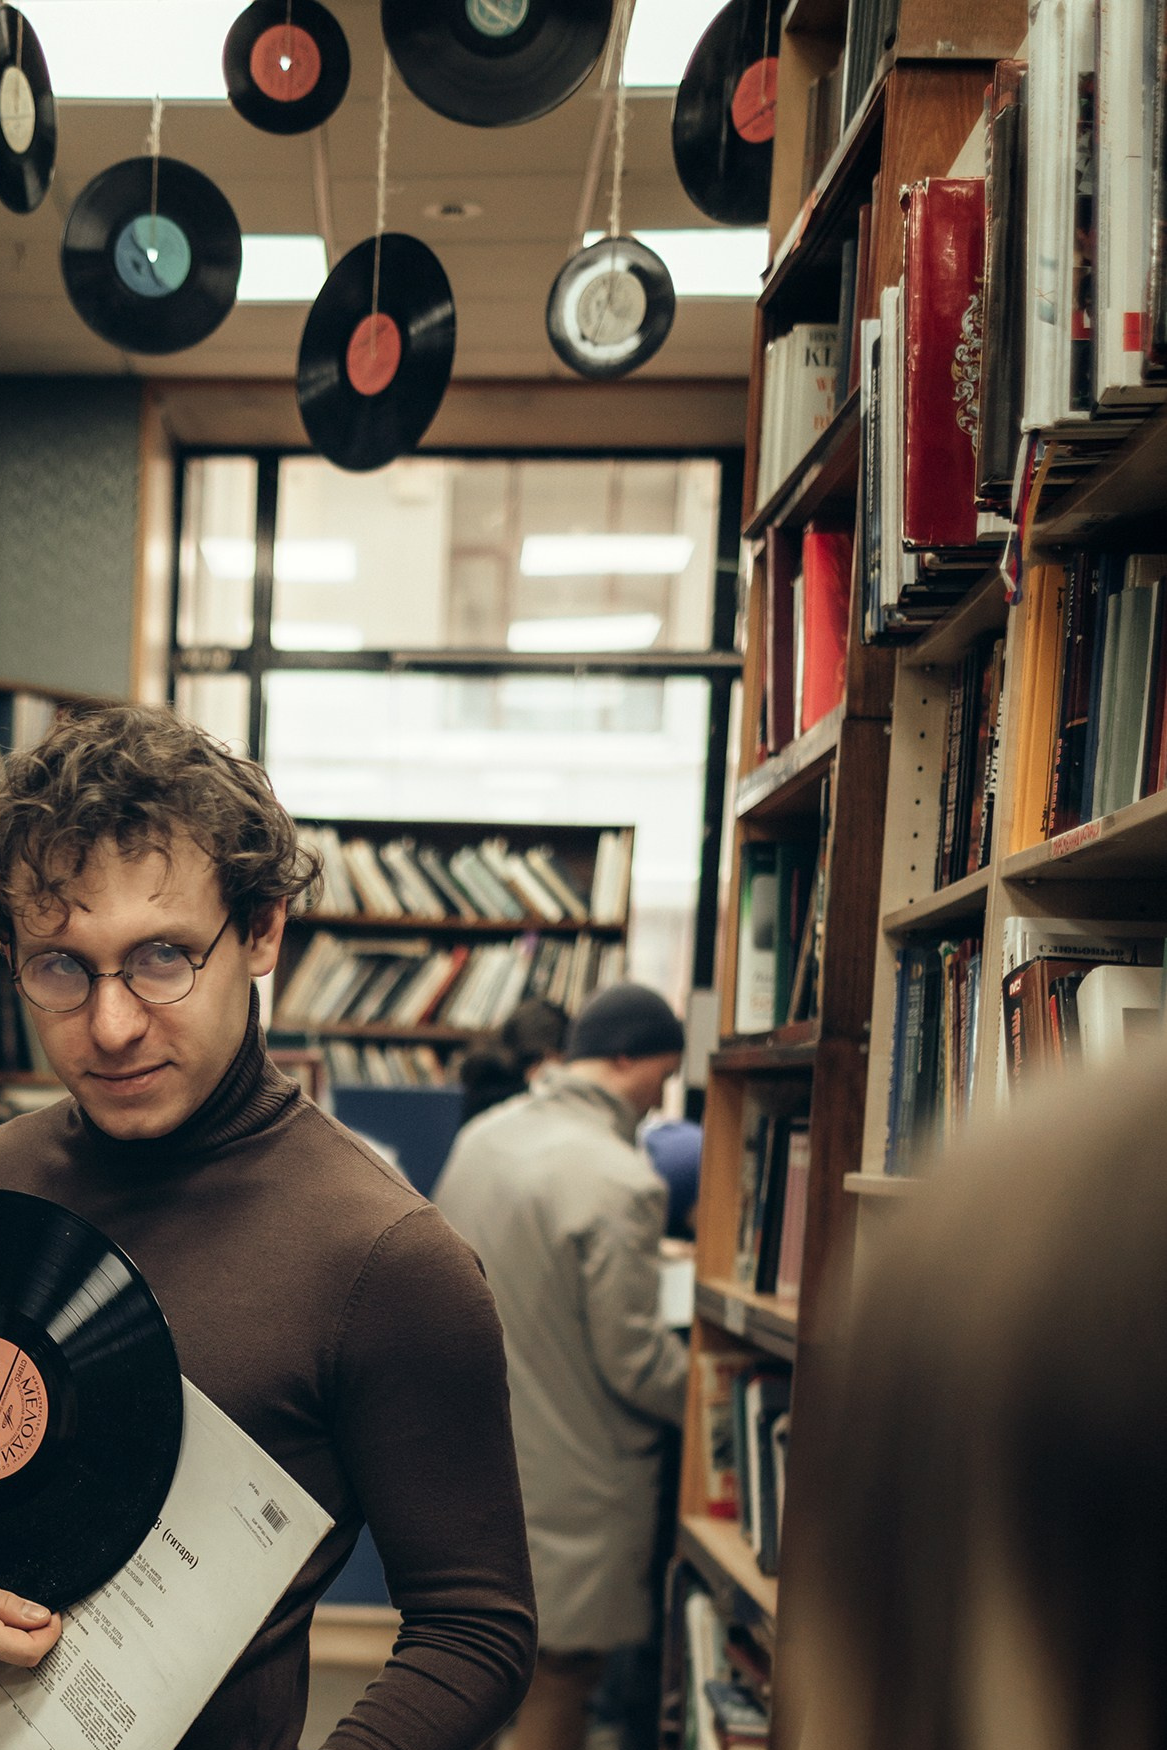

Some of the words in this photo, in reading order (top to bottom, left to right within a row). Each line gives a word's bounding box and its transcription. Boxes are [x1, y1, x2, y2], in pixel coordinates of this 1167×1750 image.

[1038, 944, 1047, 953] С
[1048, 944, 1124, 958] ЛЮБОВЬЮ
[13, 1358, 28, 1382] СТЕРЕО
[161, 1528, 200, 1569] (гитара)
[143, 1570, 160, 1587] ТАНЕЦ
[119, 1590, 136, 1607] ПЕСНИ
[92, 1616, 100, 1624] ОБ
[98, 1623, 124, 1649] АЛЬГАМБРЕ
[93, 1608, 102, 1616] НА
[99, 1614, 112, 1627] ТЕМУ
[110, 1626, 124, 1640] ХОТЫ
